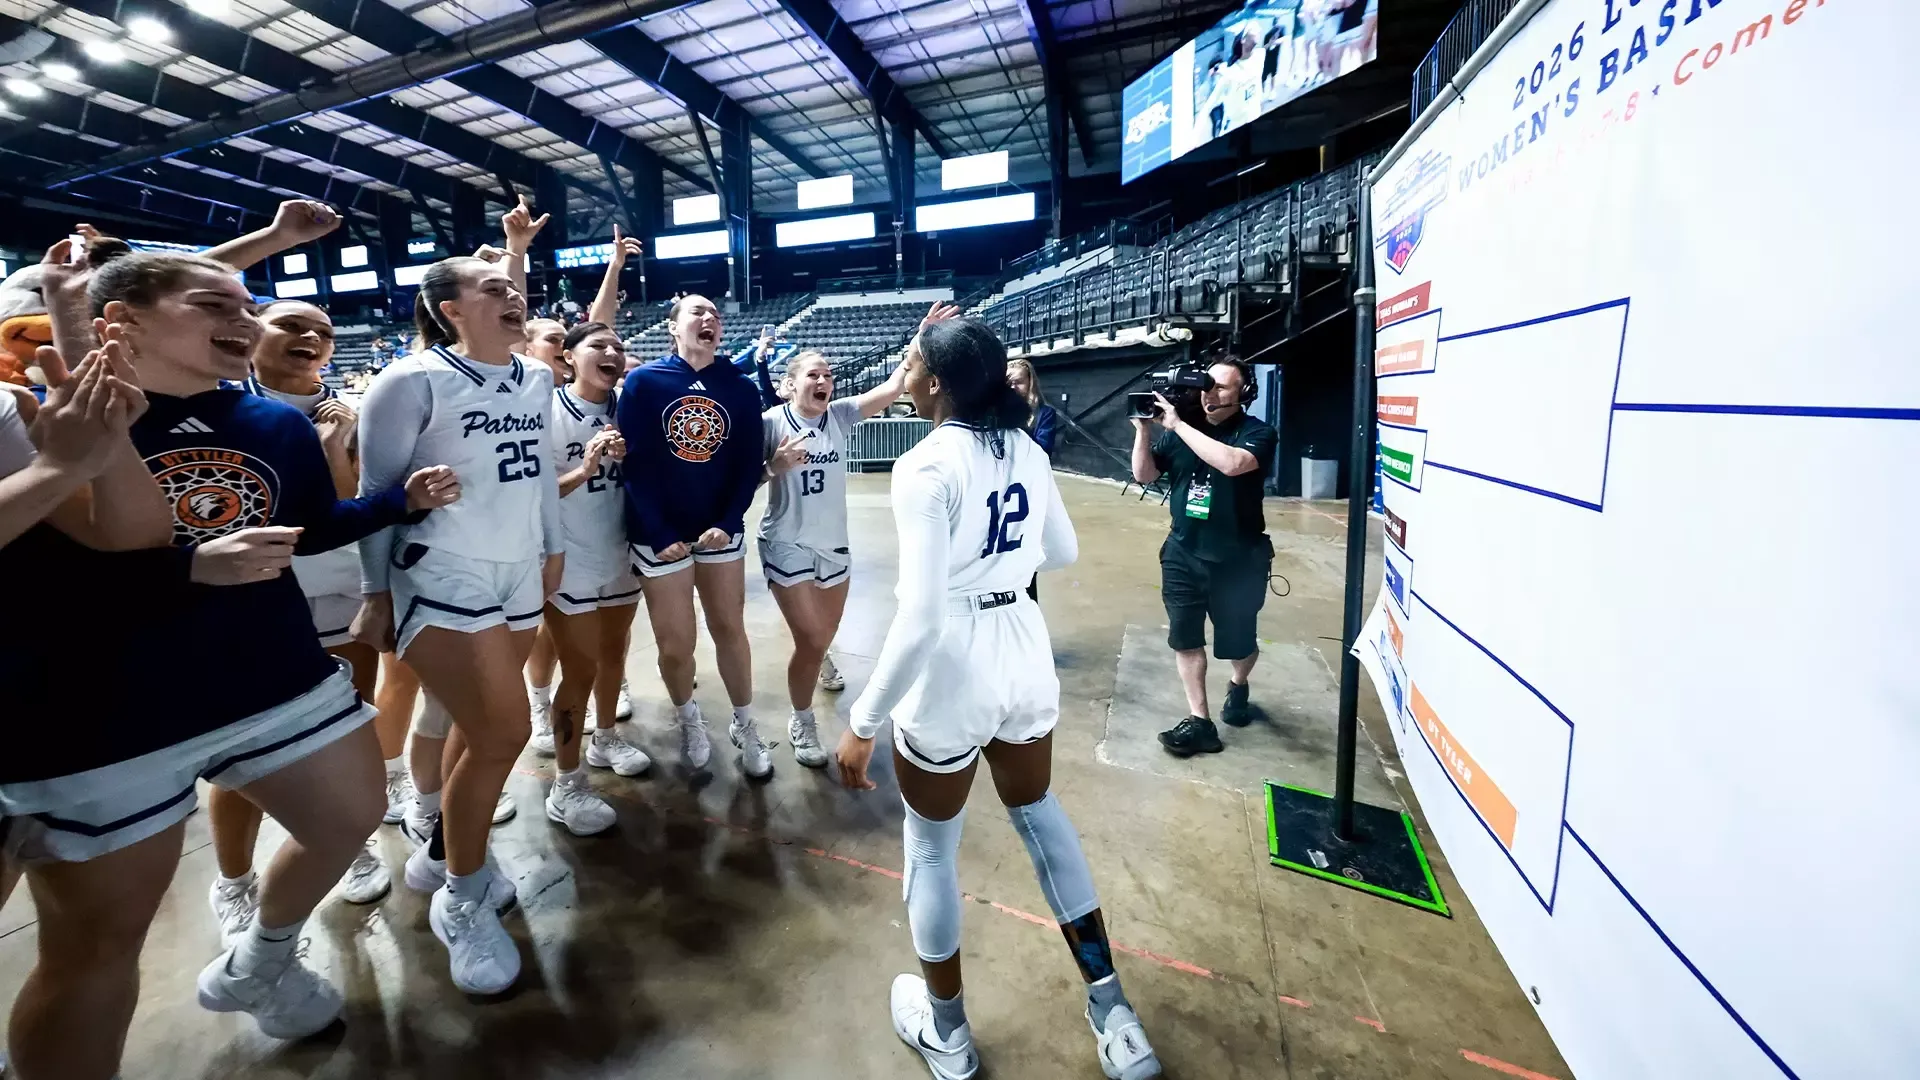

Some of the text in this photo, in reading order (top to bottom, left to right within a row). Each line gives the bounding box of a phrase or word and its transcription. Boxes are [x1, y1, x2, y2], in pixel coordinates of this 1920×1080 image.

[1512, 21, 1585, 111] 2026
[1673, 0, 1825, 86] Come
[1459, 76, 1580, 193] WOMEN'S
[495, 438, 541, 483] 25
[587, 461, 624, 493] 24
[801, 469, 825, 496] 13
[980, 482, 1029, 560] 12
[1427, 717, 1473, 785] UT TYLER
